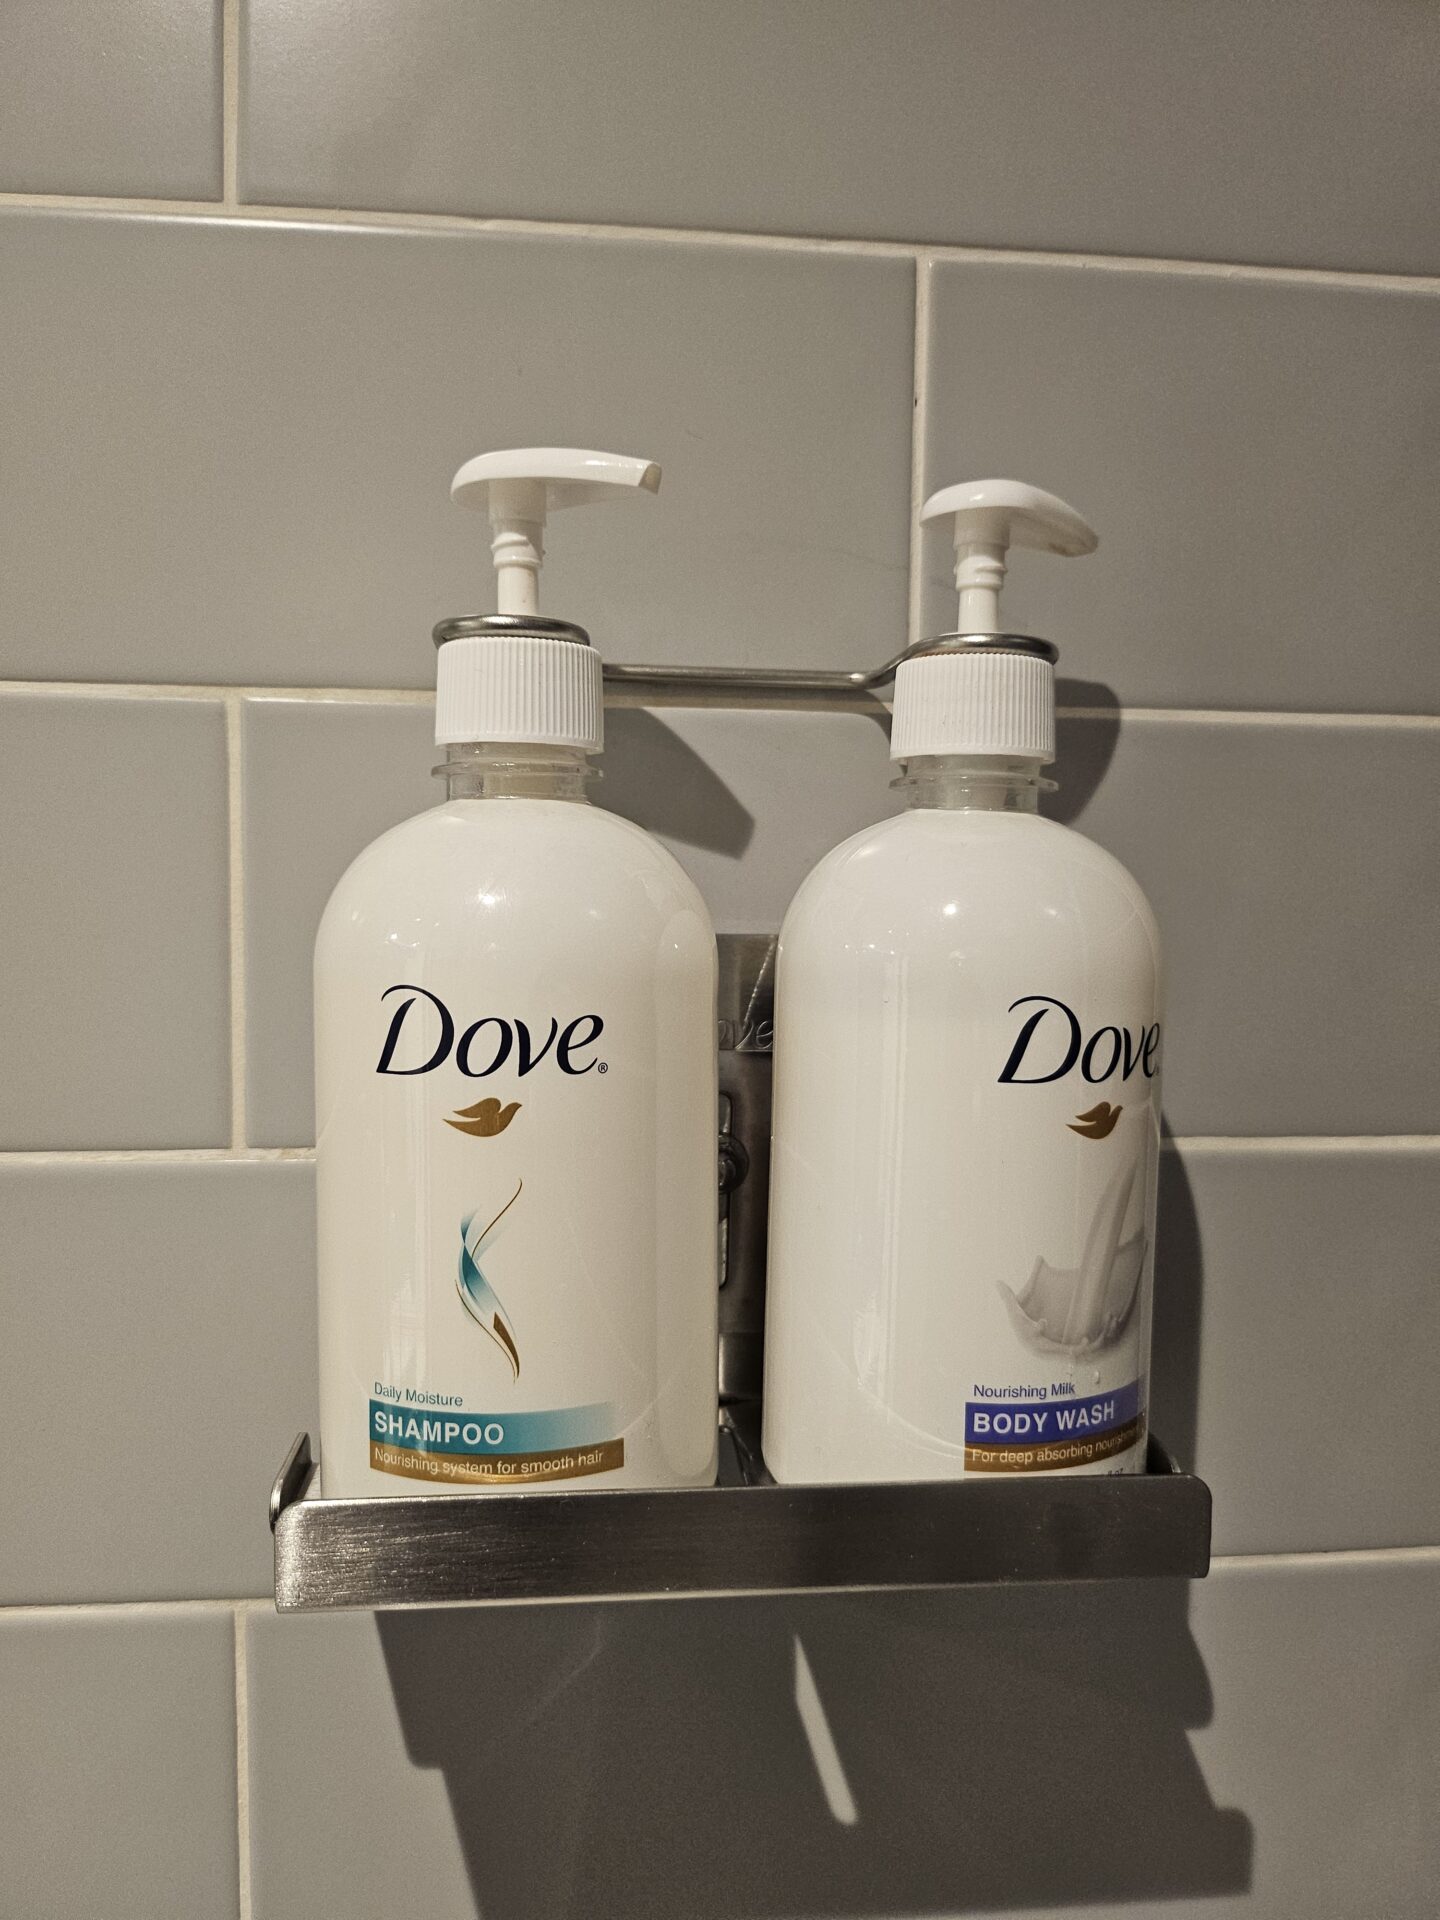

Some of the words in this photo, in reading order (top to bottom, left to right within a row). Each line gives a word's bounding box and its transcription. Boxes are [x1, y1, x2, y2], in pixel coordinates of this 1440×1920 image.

[374, 1382, 402, 1401] Daily
[405, 1388, 463, 1407] Moisture
[973, 1383, 1047, 1399] Nourishing
[1051, 1382, 1075, 1396] Milk
[374, 1411, 504, 1445] SHAMPOO
[973, 1411, 1048, 1434] BODY
[1055, 1400, 1114, 1431] WASH
[374, 1447, 439, 1473] Nourishing
[443, 1459, 493, 1477] system
[497, 1460, 517, 1474] for
[521, 1454, 574, 1473] smooth
[578, 1450, 604, 1465] hair
[972, 1449, 998, 1462] For
[1000, 1449, 1033, 1465] deep
[1037, 1442, 1093, 1462] absorbing
